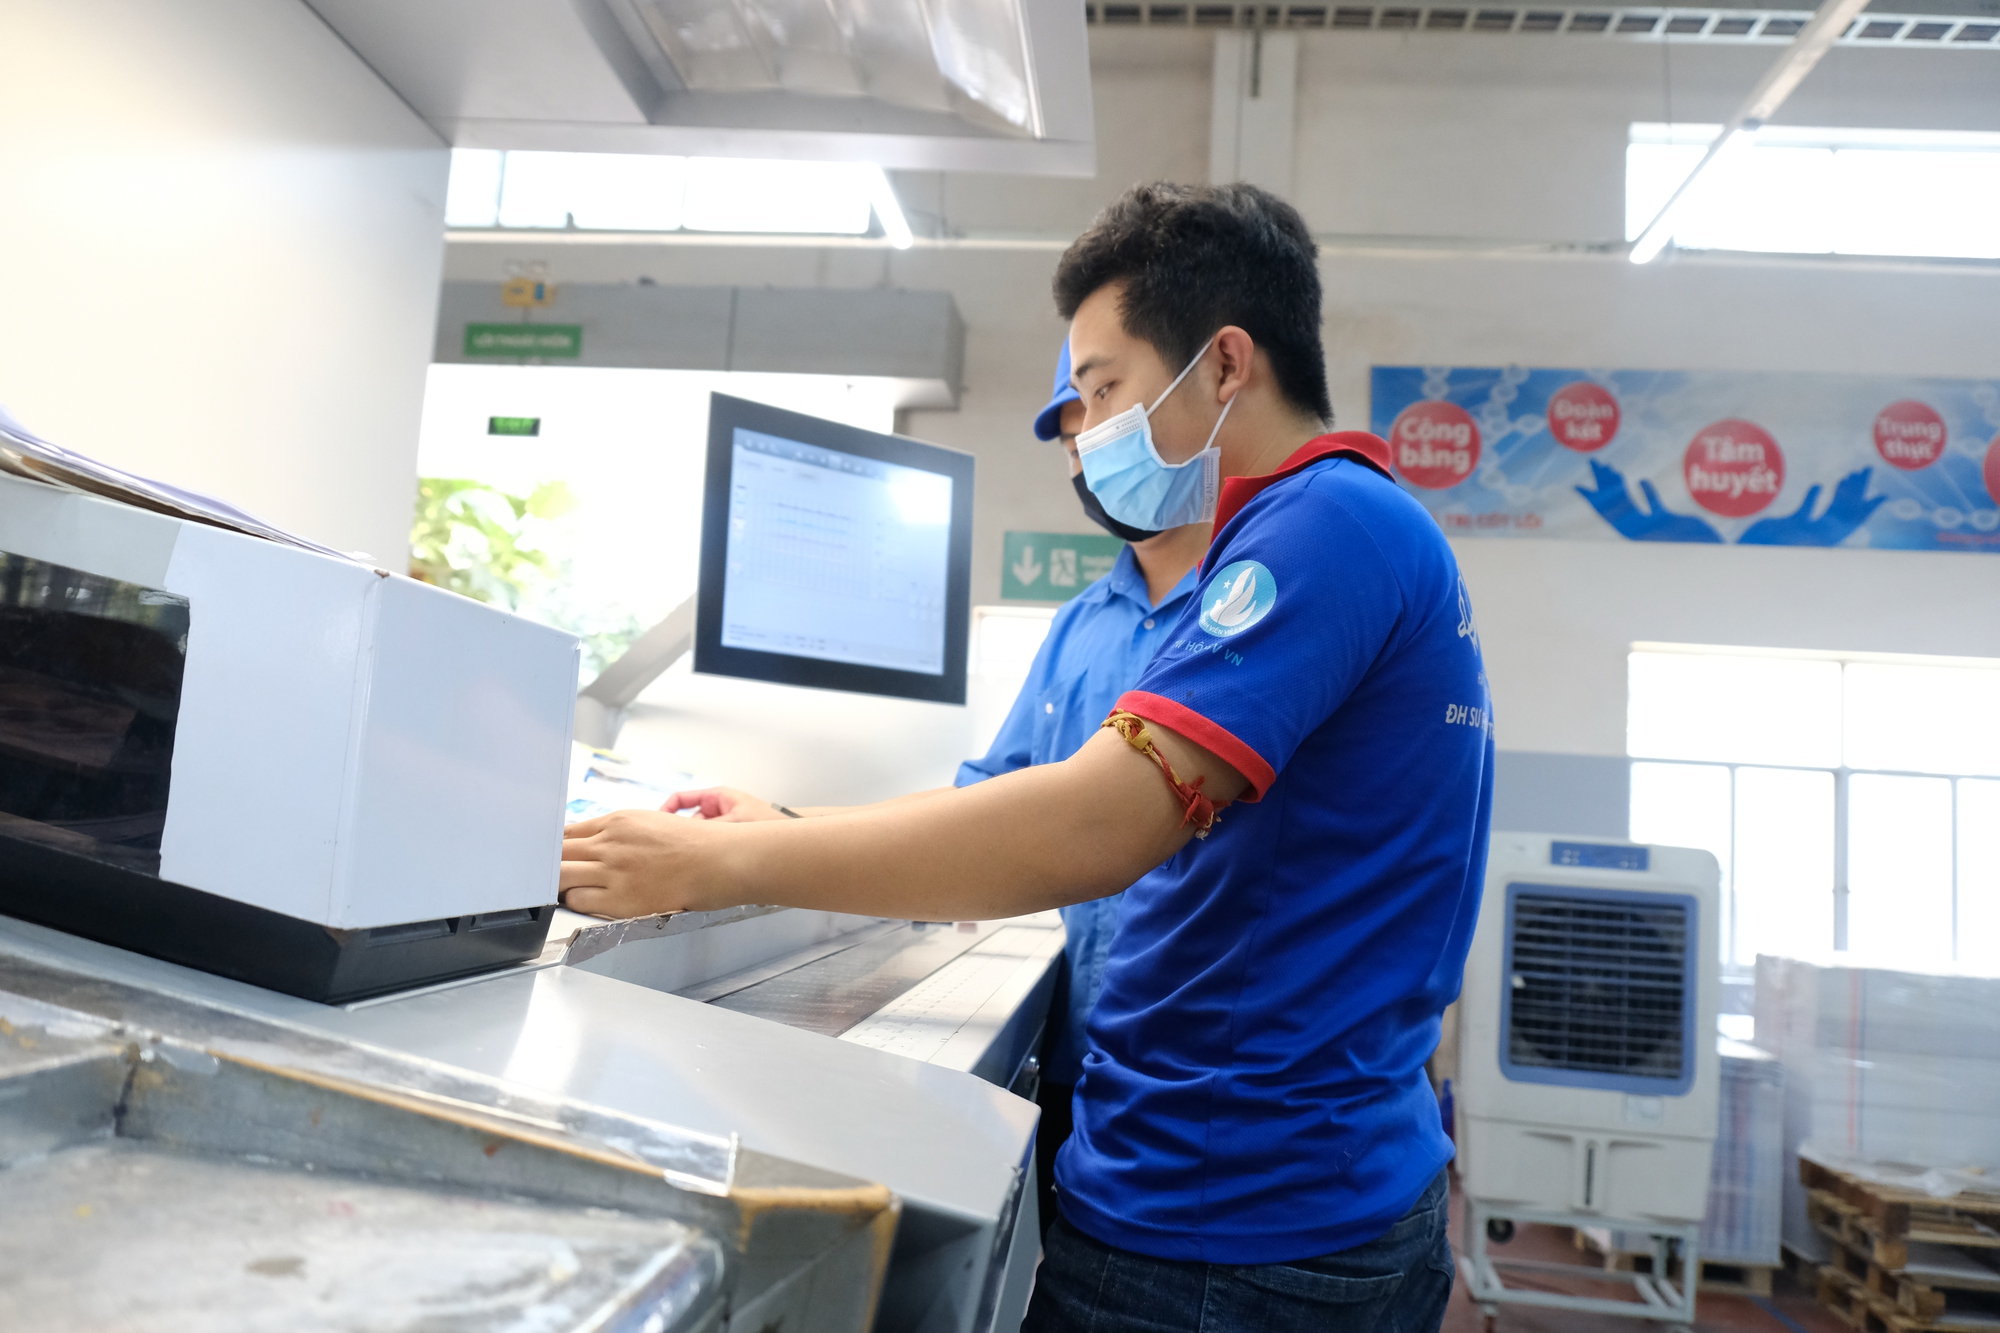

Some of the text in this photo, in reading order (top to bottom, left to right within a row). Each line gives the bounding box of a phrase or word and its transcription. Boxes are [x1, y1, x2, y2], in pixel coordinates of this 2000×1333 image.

[1401, 416, 1470, 447] Công
[1879, 416, 1941, 442] Trung
[1400, 443, 1470, 474] bằng
[1702, 435, 1765, 462] Tâm
[1883, 440, 1934, 463] thực
[1690, 463, 1778, 498] huyết
[1224, 649, 1244, 667] VN
[1445, 703, 1468, 725] ĐH
